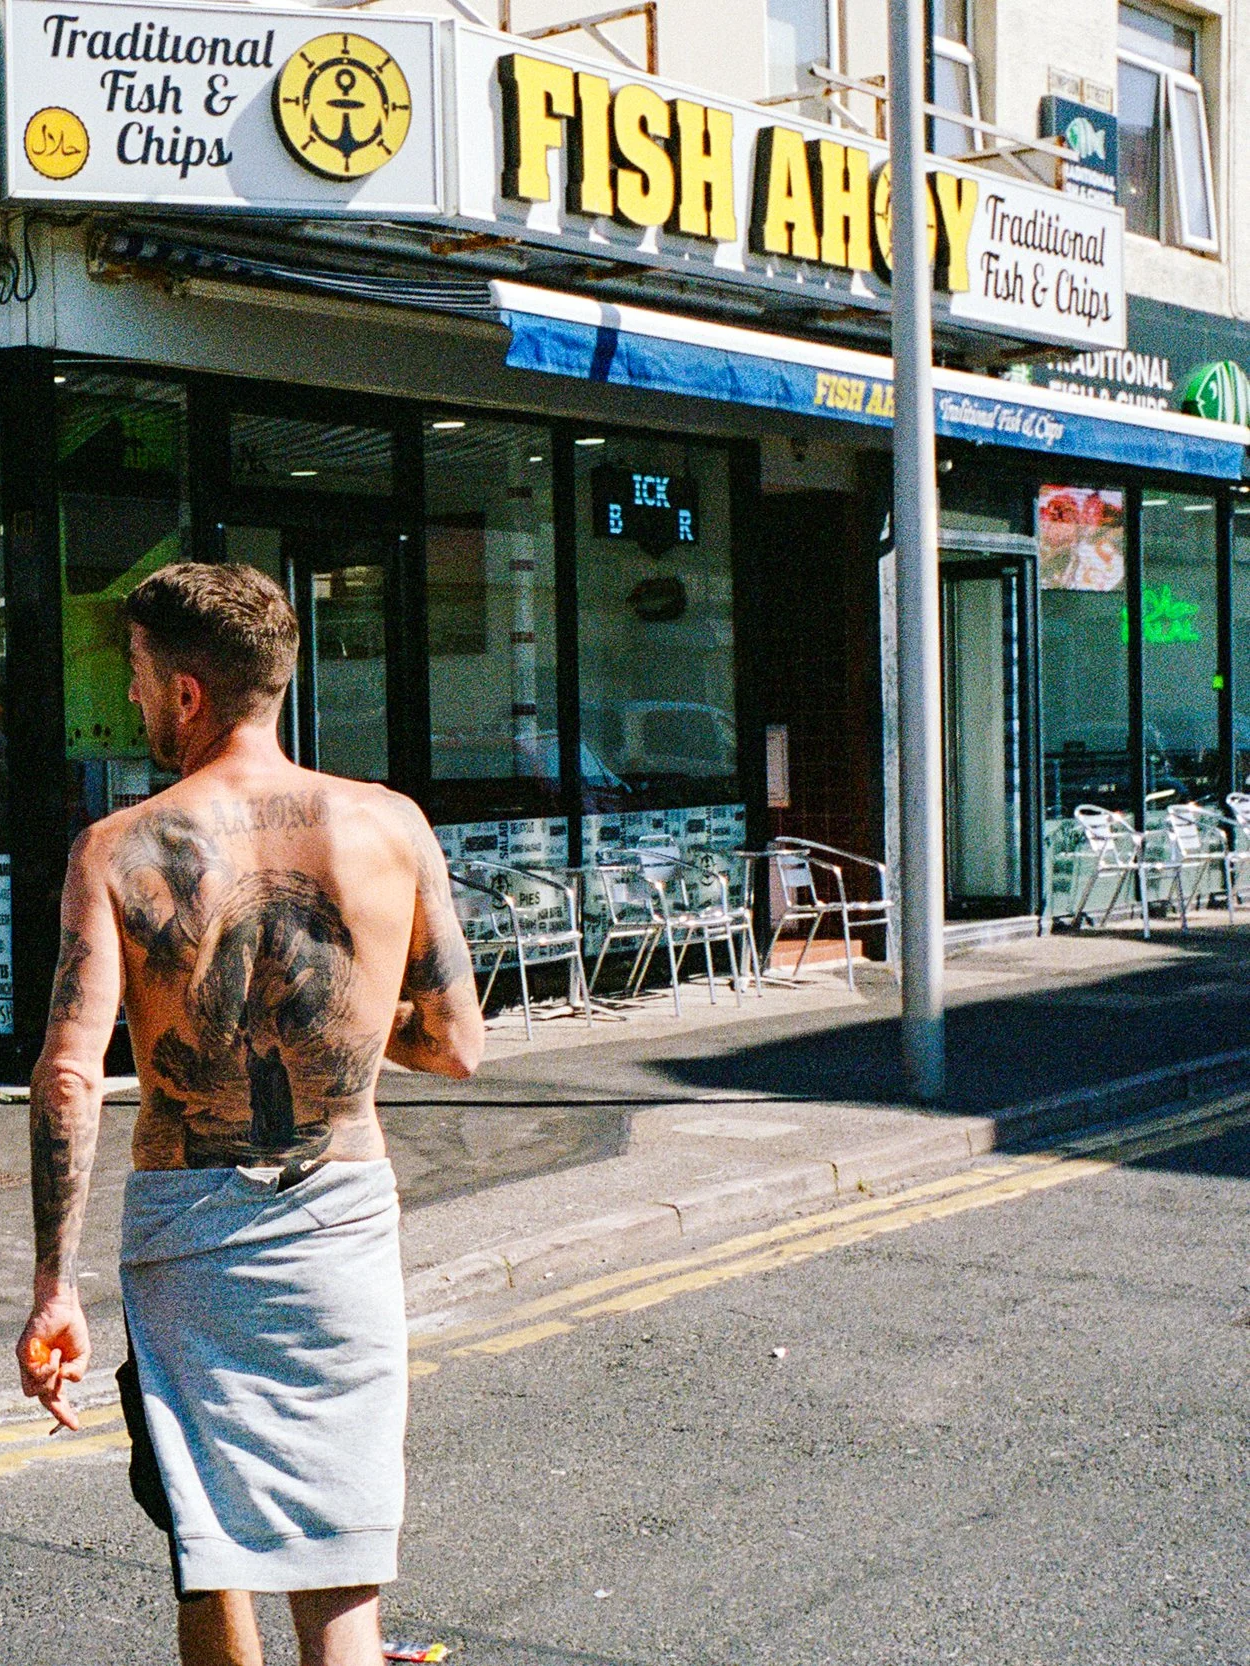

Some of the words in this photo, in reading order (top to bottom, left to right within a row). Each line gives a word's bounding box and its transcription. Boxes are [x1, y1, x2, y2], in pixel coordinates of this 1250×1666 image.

[43, 15, 275, 68] Traditional
[100, 69, 181, 114] Fish
[204, 75, 238, 117] &
[116, 121, 233, 179] Chips
[497, 53, 738, 242] FISH
[985, 194, 1106, 267] Traditional
[980, 250, 1025, 304] Fish
[1031, 262, 1049, 308] &
[1055, 268, 1113, 328] Chips
[813, 372, 867, 413] FISH
[865, 384, 895, 418] AH
[518, 891, 541, 906] PIES
